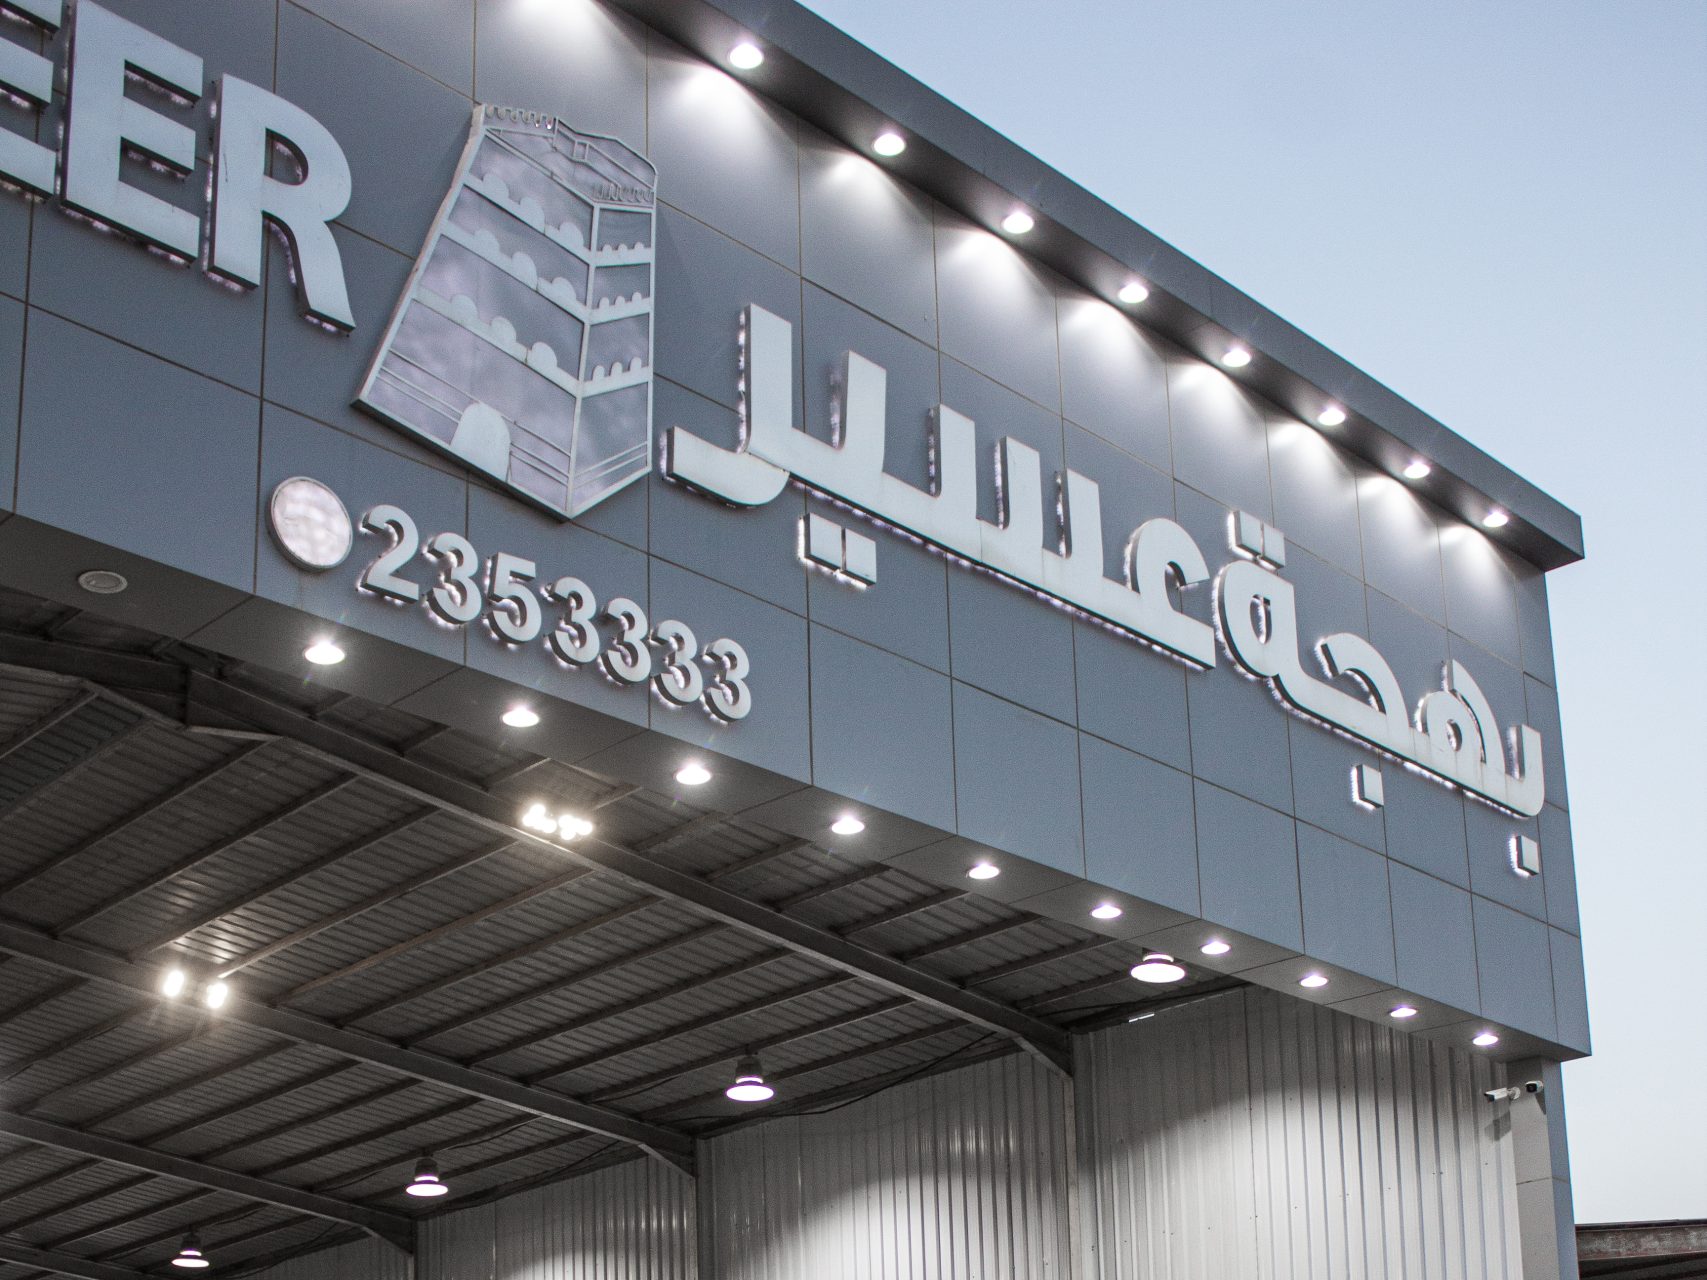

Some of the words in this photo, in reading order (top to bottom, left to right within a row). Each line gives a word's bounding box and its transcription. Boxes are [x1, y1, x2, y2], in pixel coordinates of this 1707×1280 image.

[358, 505, 752, 722] 2353333
[662, 303, 1217, 669] عسير
[1214, 509, 1545, 876] بهجة
